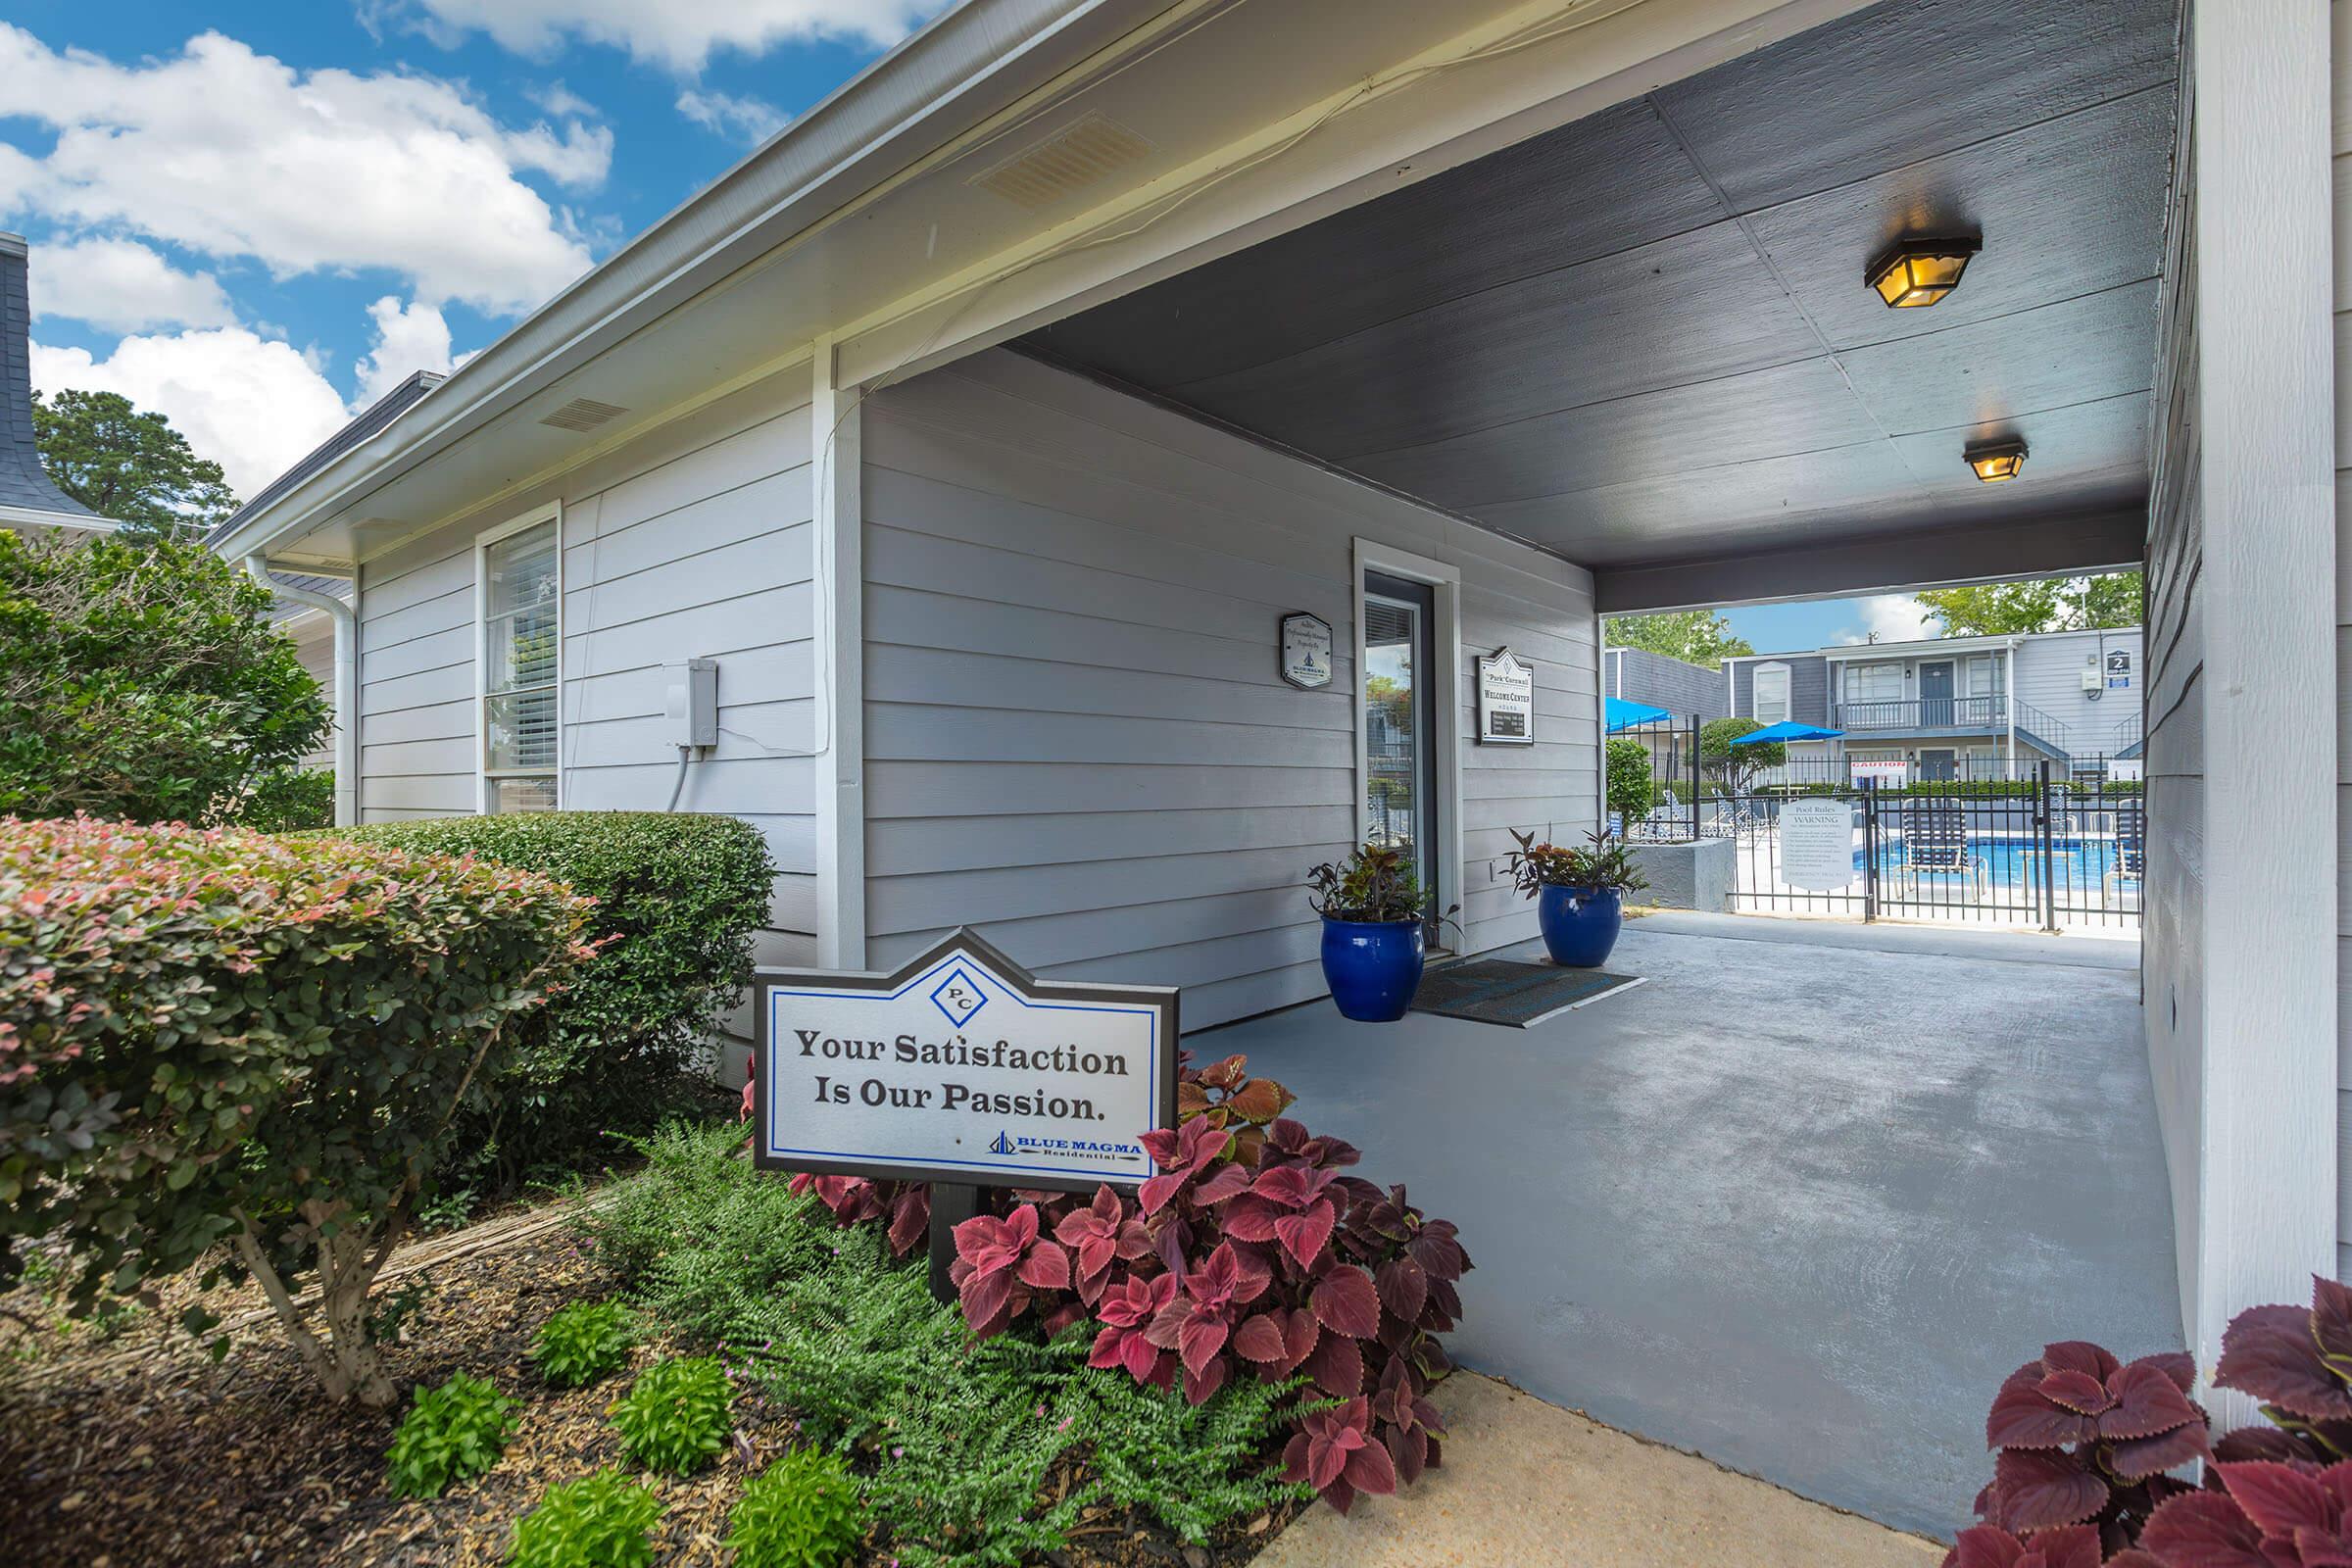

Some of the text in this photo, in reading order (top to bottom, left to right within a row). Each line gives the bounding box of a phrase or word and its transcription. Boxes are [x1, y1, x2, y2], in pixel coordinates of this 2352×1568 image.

[2114, 658, 2124, 668] 2
[1490, 673, 1503, 682] Park
[1484, 689, 1530, 703] WELCOME CENTER
[794, 1029, 1129, 1076] Your Satisfaction
[813, 1076, 1106, 1121] Is Our Passion.
[1016, 1137, 1143, 1155] BLUE MAGMA
[1043, 1149, 1116, 1161] Residential
